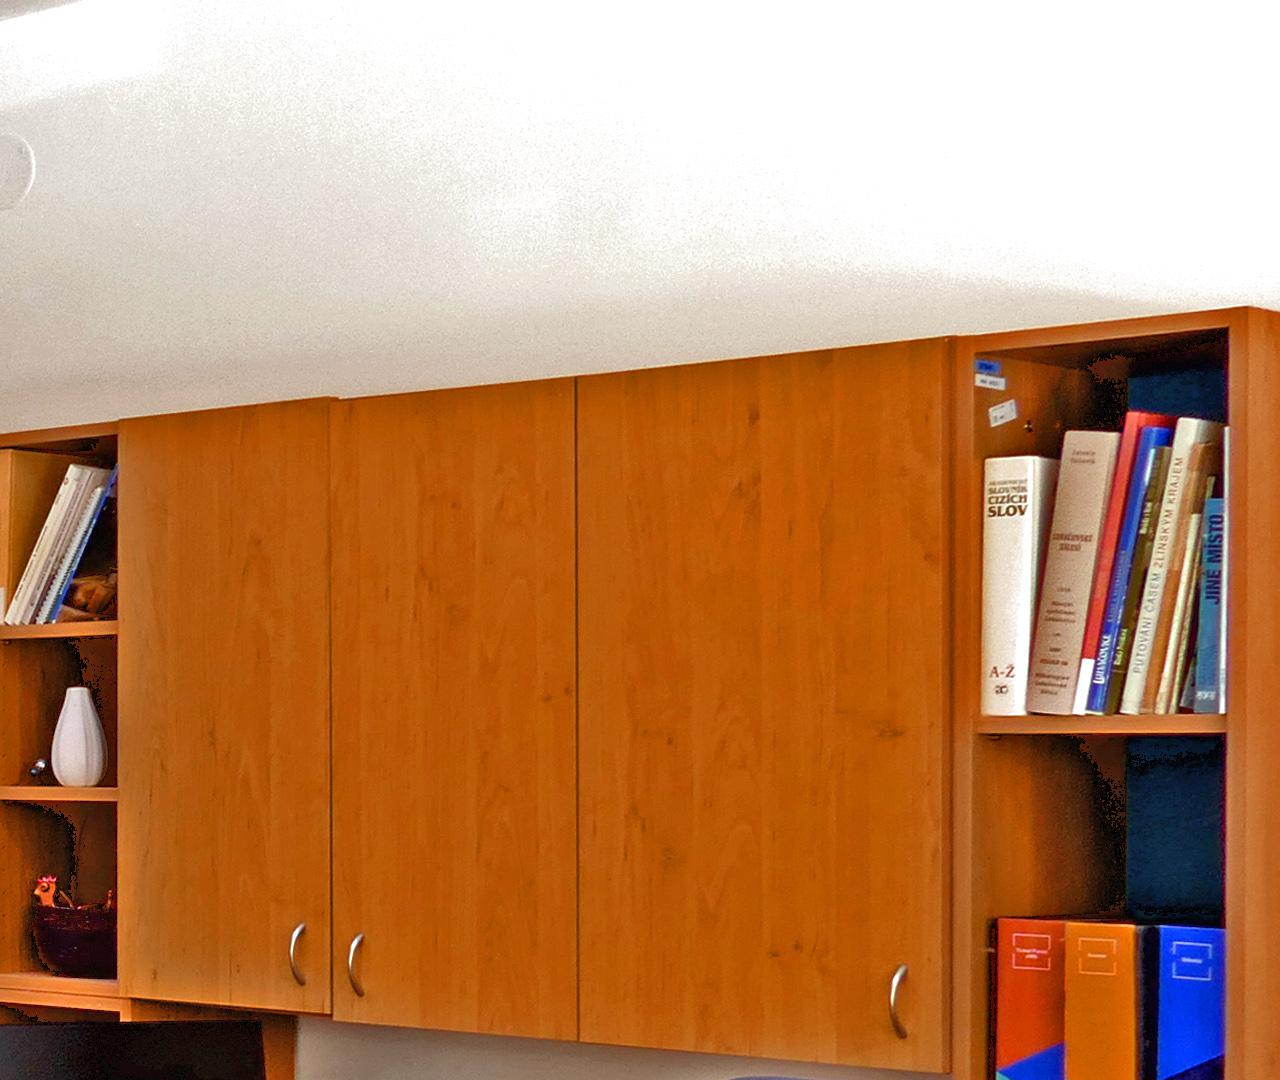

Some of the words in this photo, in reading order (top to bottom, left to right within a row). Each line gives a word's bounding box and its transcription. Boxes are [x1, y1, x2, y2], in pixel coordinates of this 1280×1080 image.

[988, 494, 1028, 505] CIZÍCH
[988, 505, 1028, 518] SLOV
[1204, 514, 1225, 563] MÍSTO
